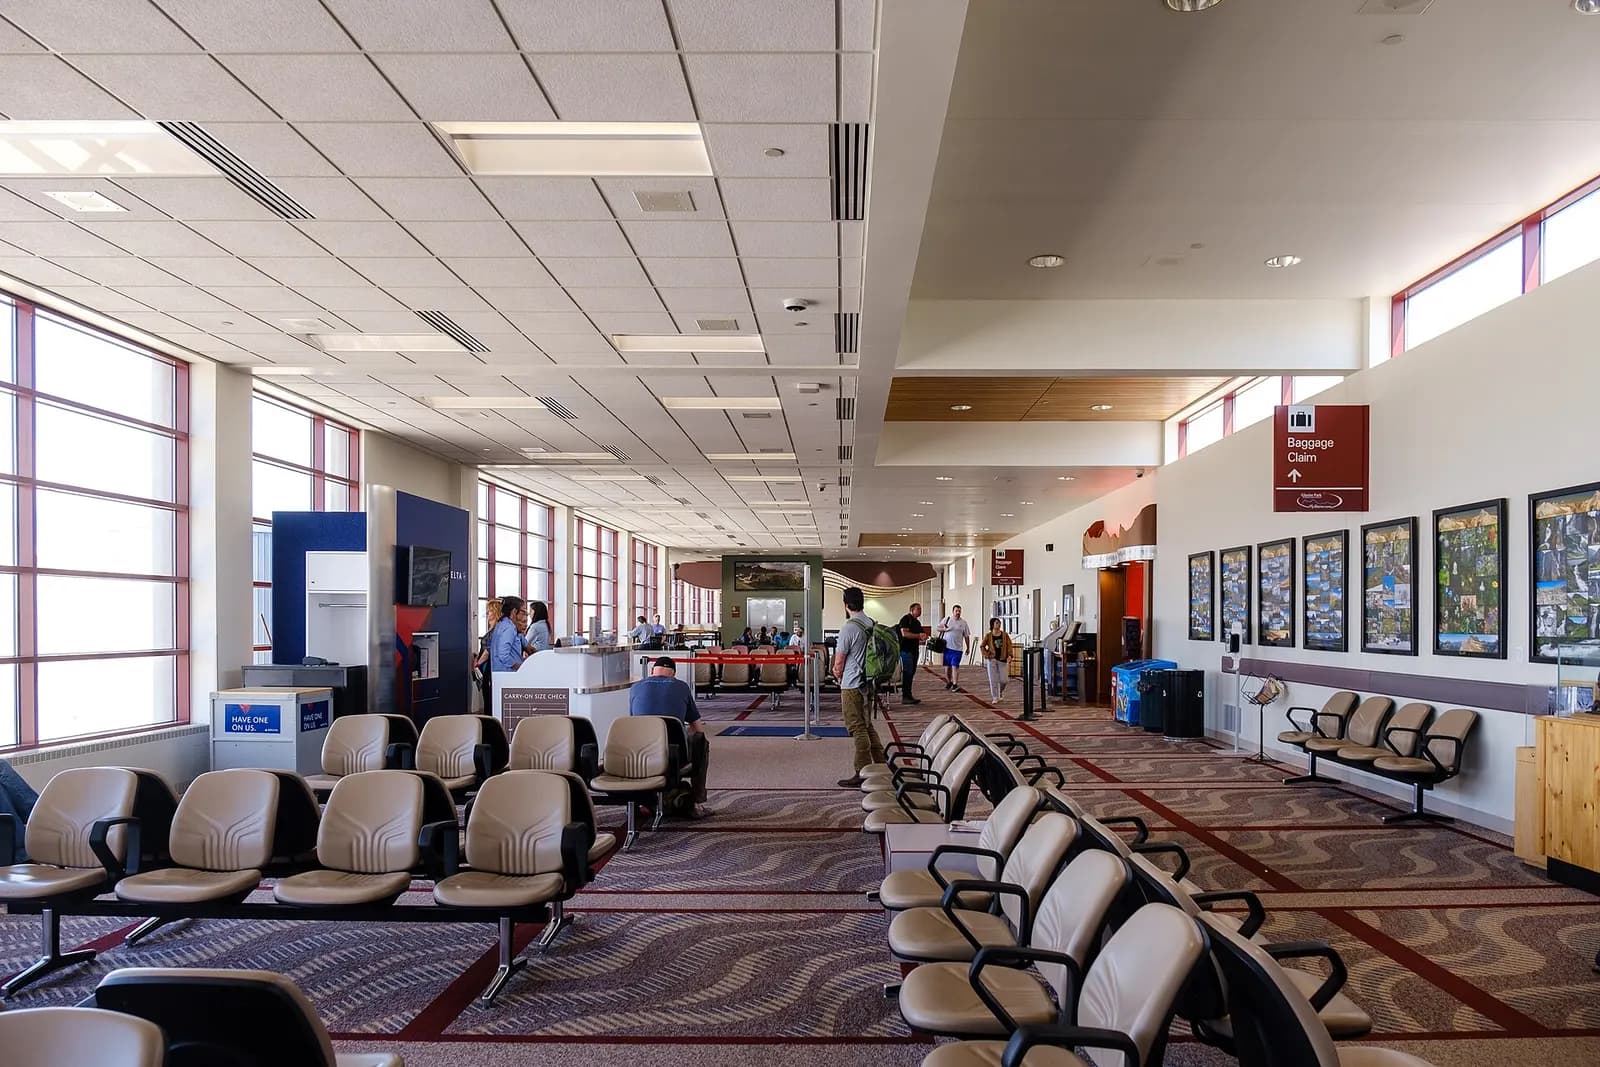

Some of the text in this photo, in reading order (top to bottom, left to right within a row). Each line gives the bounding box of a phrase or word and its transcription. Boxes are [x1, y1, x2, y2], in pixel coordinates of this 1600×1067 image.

[1287, 437, 1334, 450] Baggage
[1287, 452, 1317, 463] Claim
[450, 570, 463, 580] ELTA
[252, 716, 269, 724] ONE
[303, 713, 314, 721] HAVE
[244, 724, 257, 732] US.
